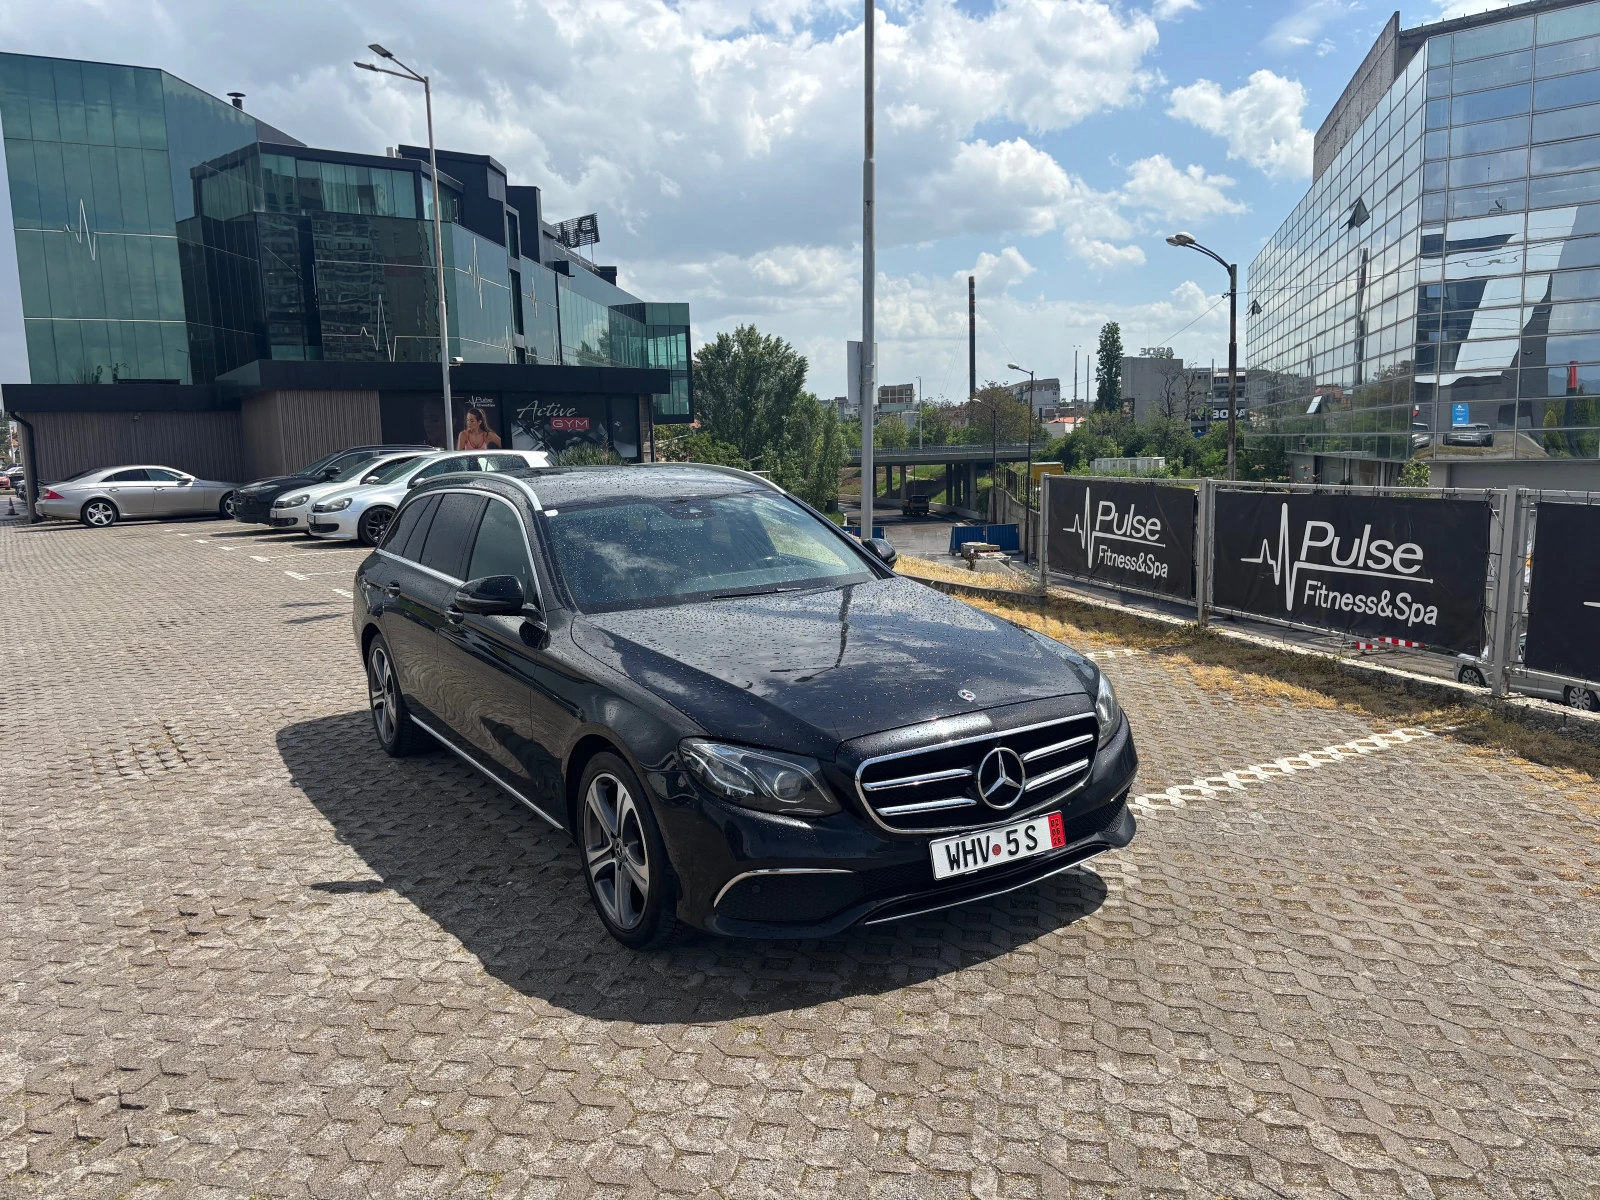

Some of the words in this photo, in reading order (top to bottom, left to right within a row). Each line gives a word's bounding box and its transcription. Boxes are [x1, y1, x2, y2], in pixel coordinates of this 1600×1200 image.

[516, 400, 577, 420] Active
[552, 419, 588, 428] GYM
[1095, 500, 1161, 541] Pulse
[1097, 545, 1168, 579] Fitness&Spa
[1300, 520, 1424, 574] Pulse
[1303, 579, 1439, 627] Fitness&Spa
[945, 835, 990, 871] WHV
